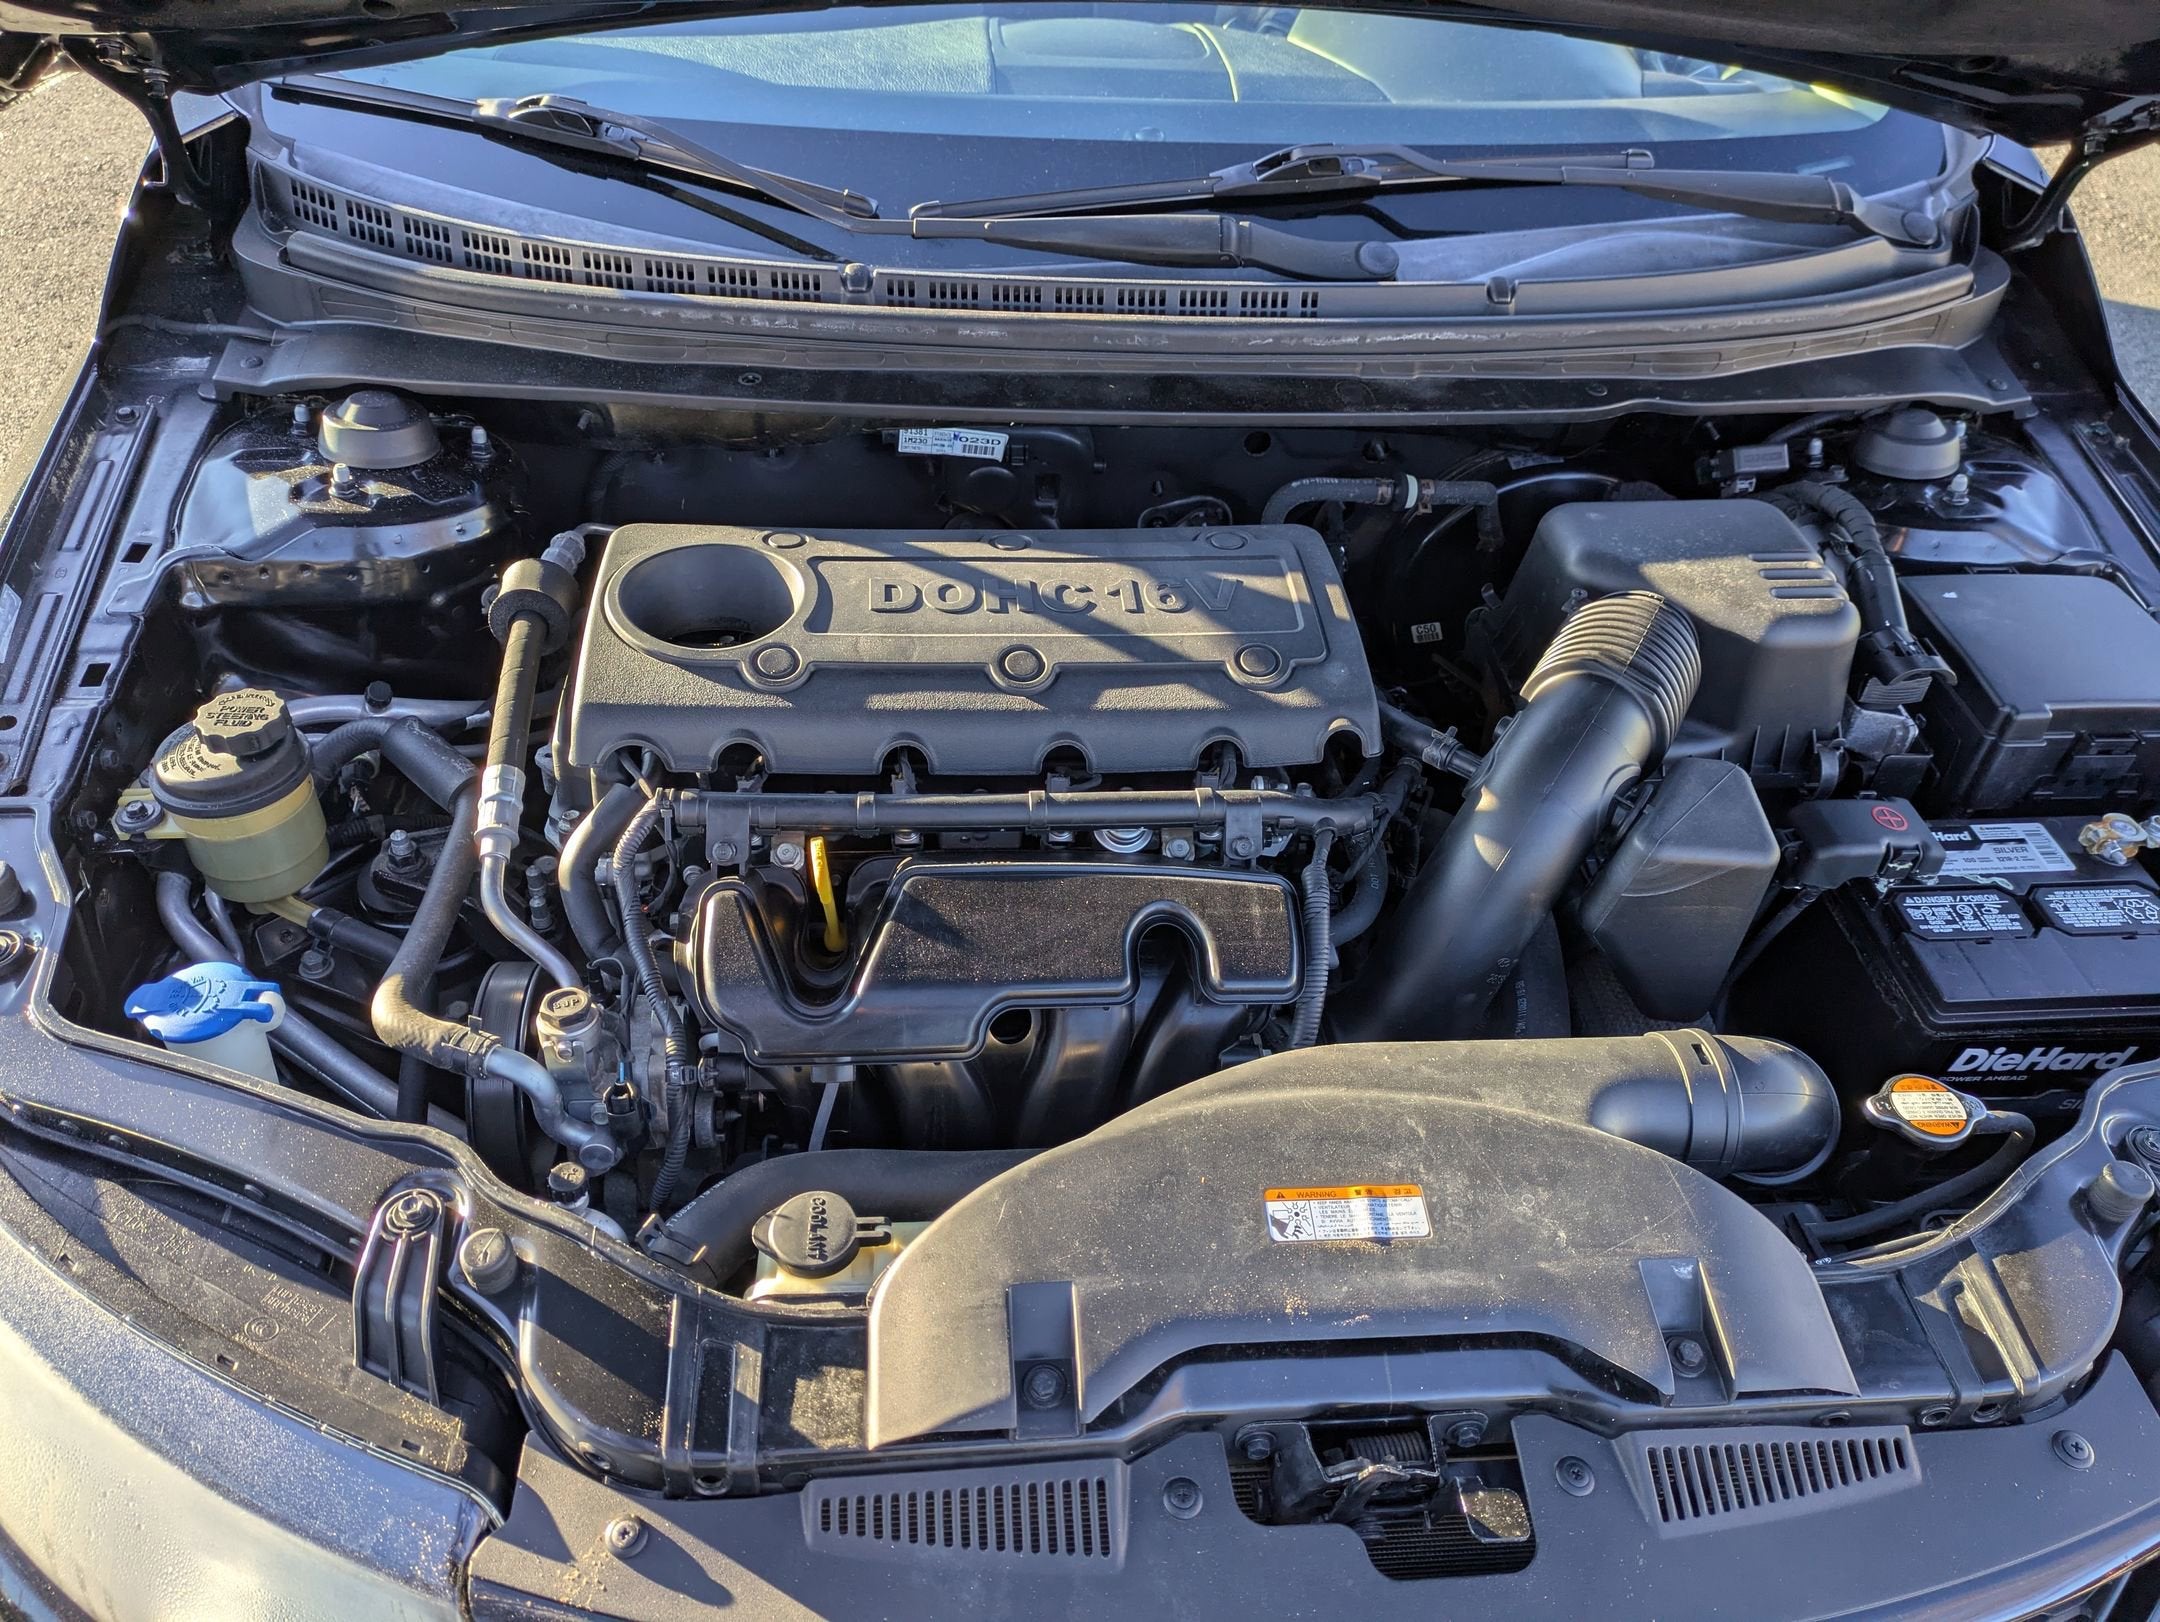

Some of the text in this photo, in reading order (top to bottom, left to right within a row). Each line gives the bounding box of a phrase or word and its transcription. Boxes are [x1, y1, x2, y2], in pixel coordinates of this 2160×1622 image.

[868, 577, 1244, 614] DOHC 16V
[1416, 623, 1437, 635] C50
[219, 705, 266, 714] POWER
[205, 712, 270, 721] STEERING
[213, 719, 253, 727] FLUID
[1993, 846, 2029, 854] SILVER
[1913, 895, 1954, 904] DANGER
[1961, 894, 1999, 902] POISON
[1947, 1046, 2140, 1073] DieHard
[1297, 1190, 1337, 1198] WARNING
[807, 1197, 828, 1262] COOLANT
